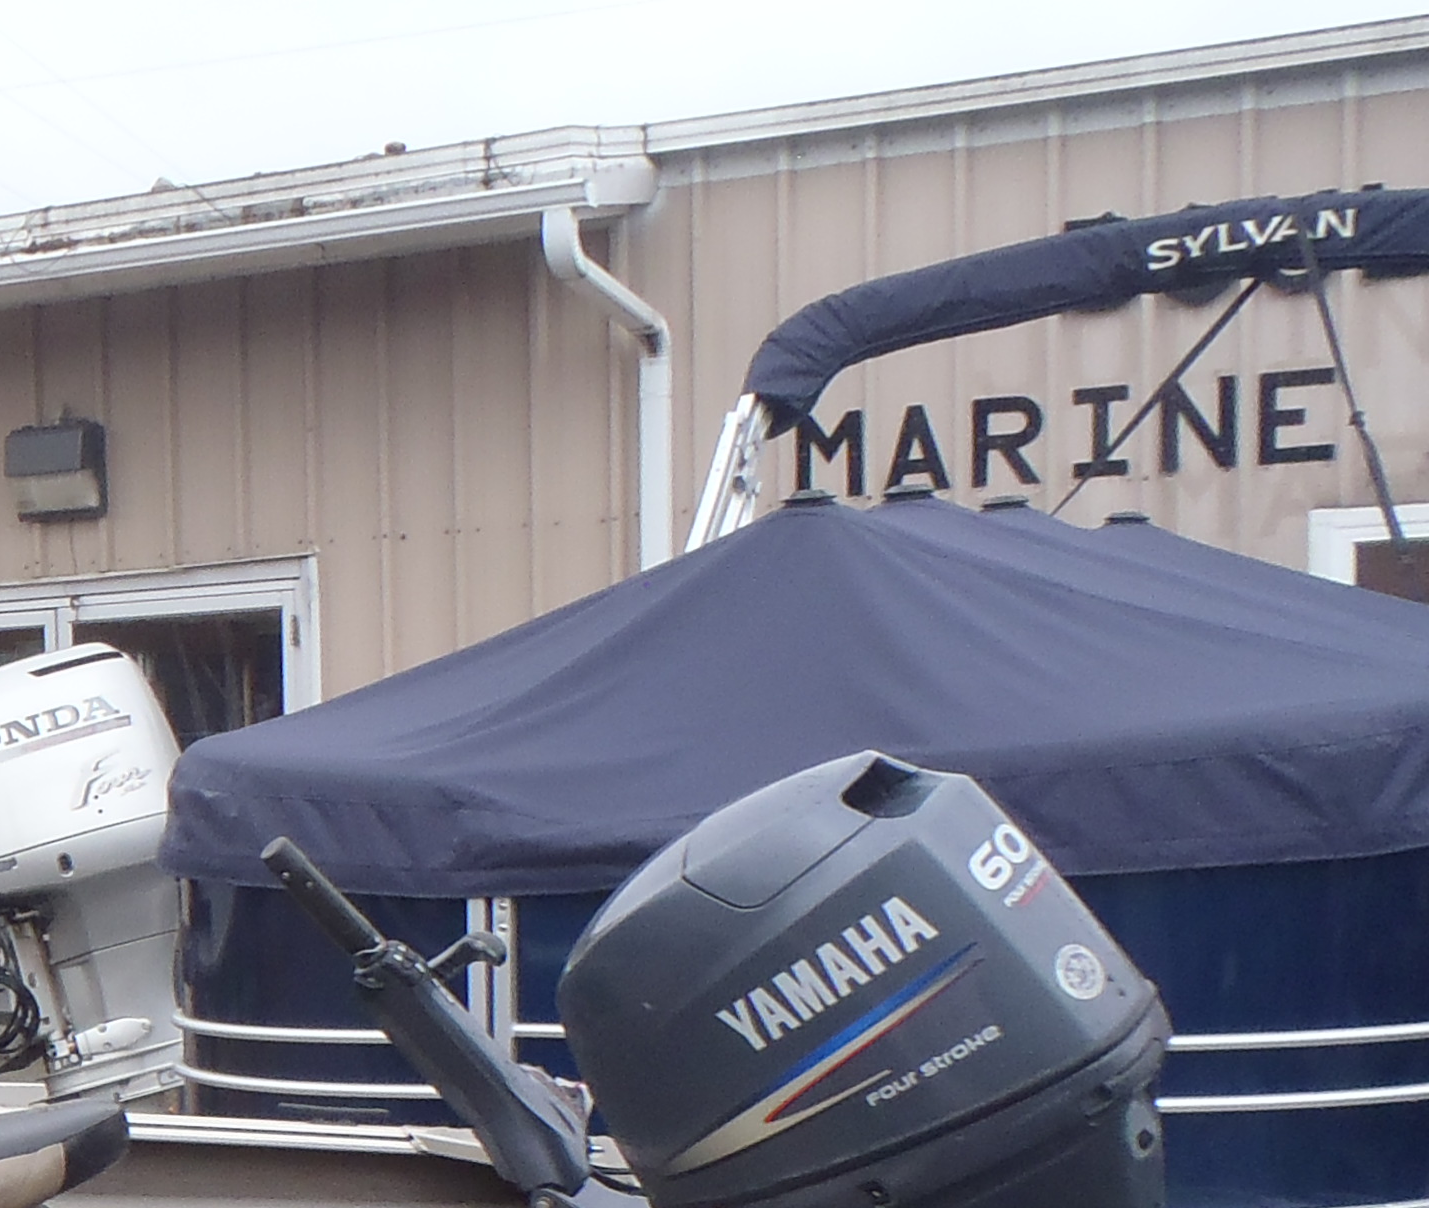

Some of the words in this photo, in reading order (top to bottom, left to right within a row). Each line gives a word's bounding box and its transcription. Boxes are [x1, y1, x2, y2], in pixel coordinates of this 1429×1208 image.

[1146, 208, 1358, 271] SYLVAN
[795, 367, 1337, 497] MARINE
[968, 823, 1029, 891] 60
[716, 896, 939, 1052] YAMAHA
